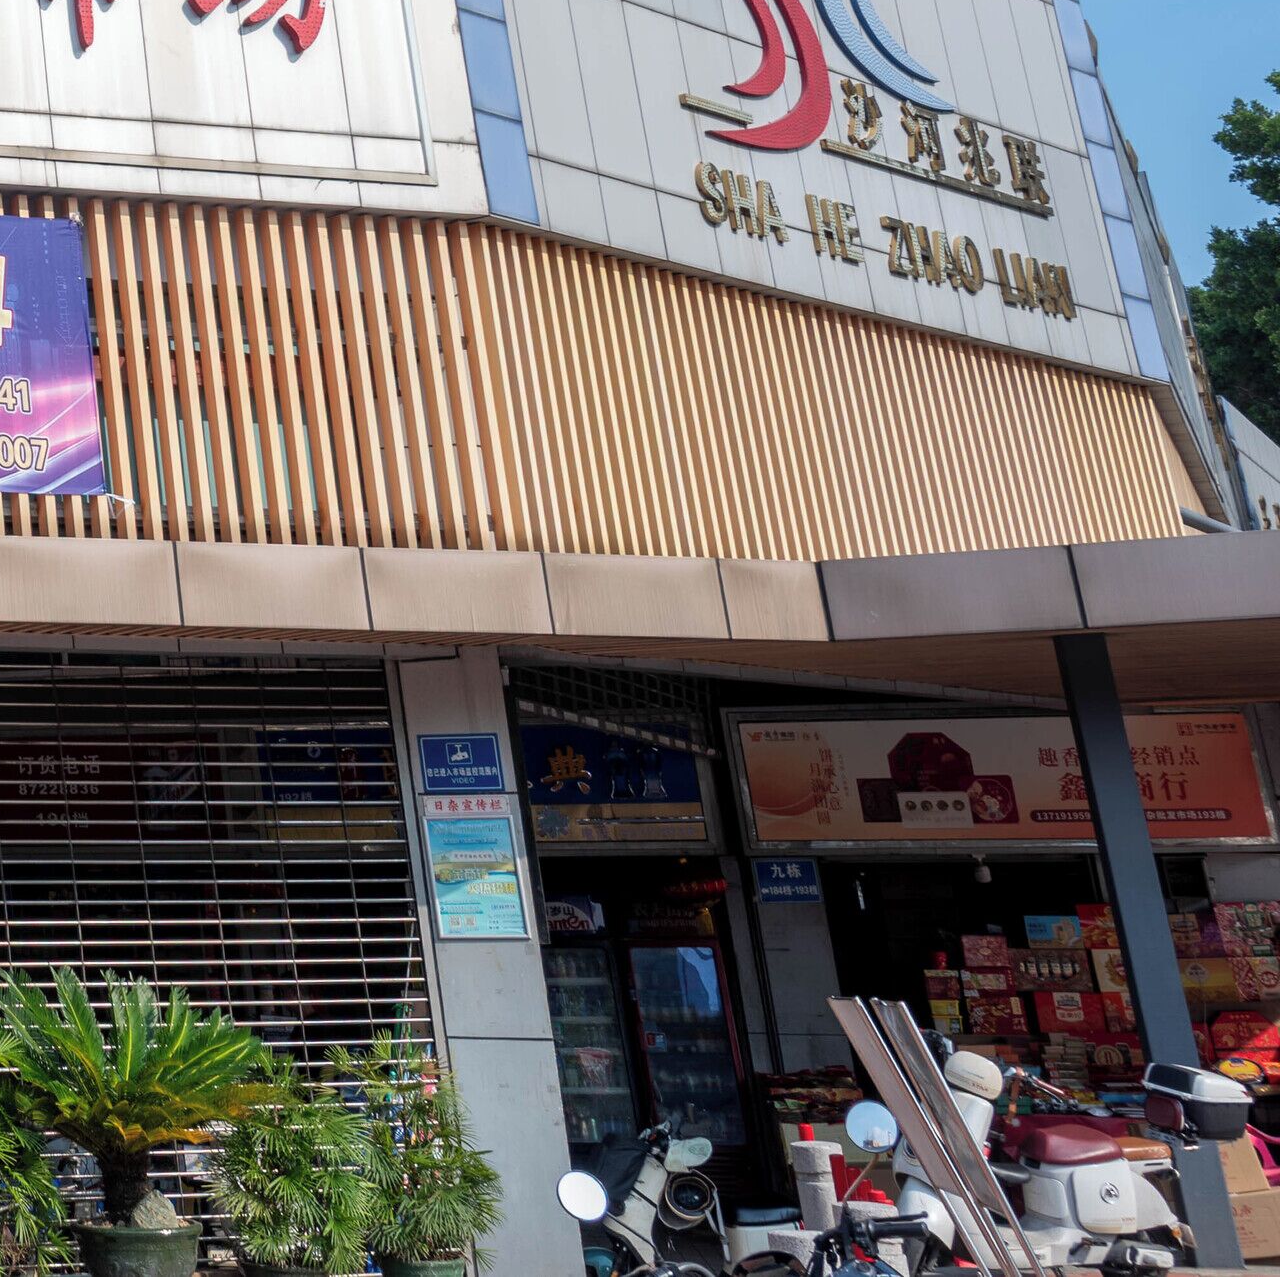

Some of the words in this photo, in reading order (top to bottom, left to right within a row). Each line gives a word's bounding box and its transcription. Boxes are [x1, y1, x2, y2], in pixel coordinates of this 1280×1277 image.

[840, 77, 1051, 207] 沙河兆联
[693, 161, 791, 245] SHA
[805, 191, 865, 266] HE
[879, 215, 984, 296] ZHAO
[992, 246, 1078, 323] LIAN
[16, 753, 102, 777] 订货电话
[426, 766, 498, 778] 您已进入市场监控范围内
[451, 776, 476, 784] VIDEO
[433, 798, 504, 812] 日杂宣传栏
[769, 862, 803, 879] 九栋
[547, 905, 575, 916] 岁山
[547, 915, 590, 932] anten
